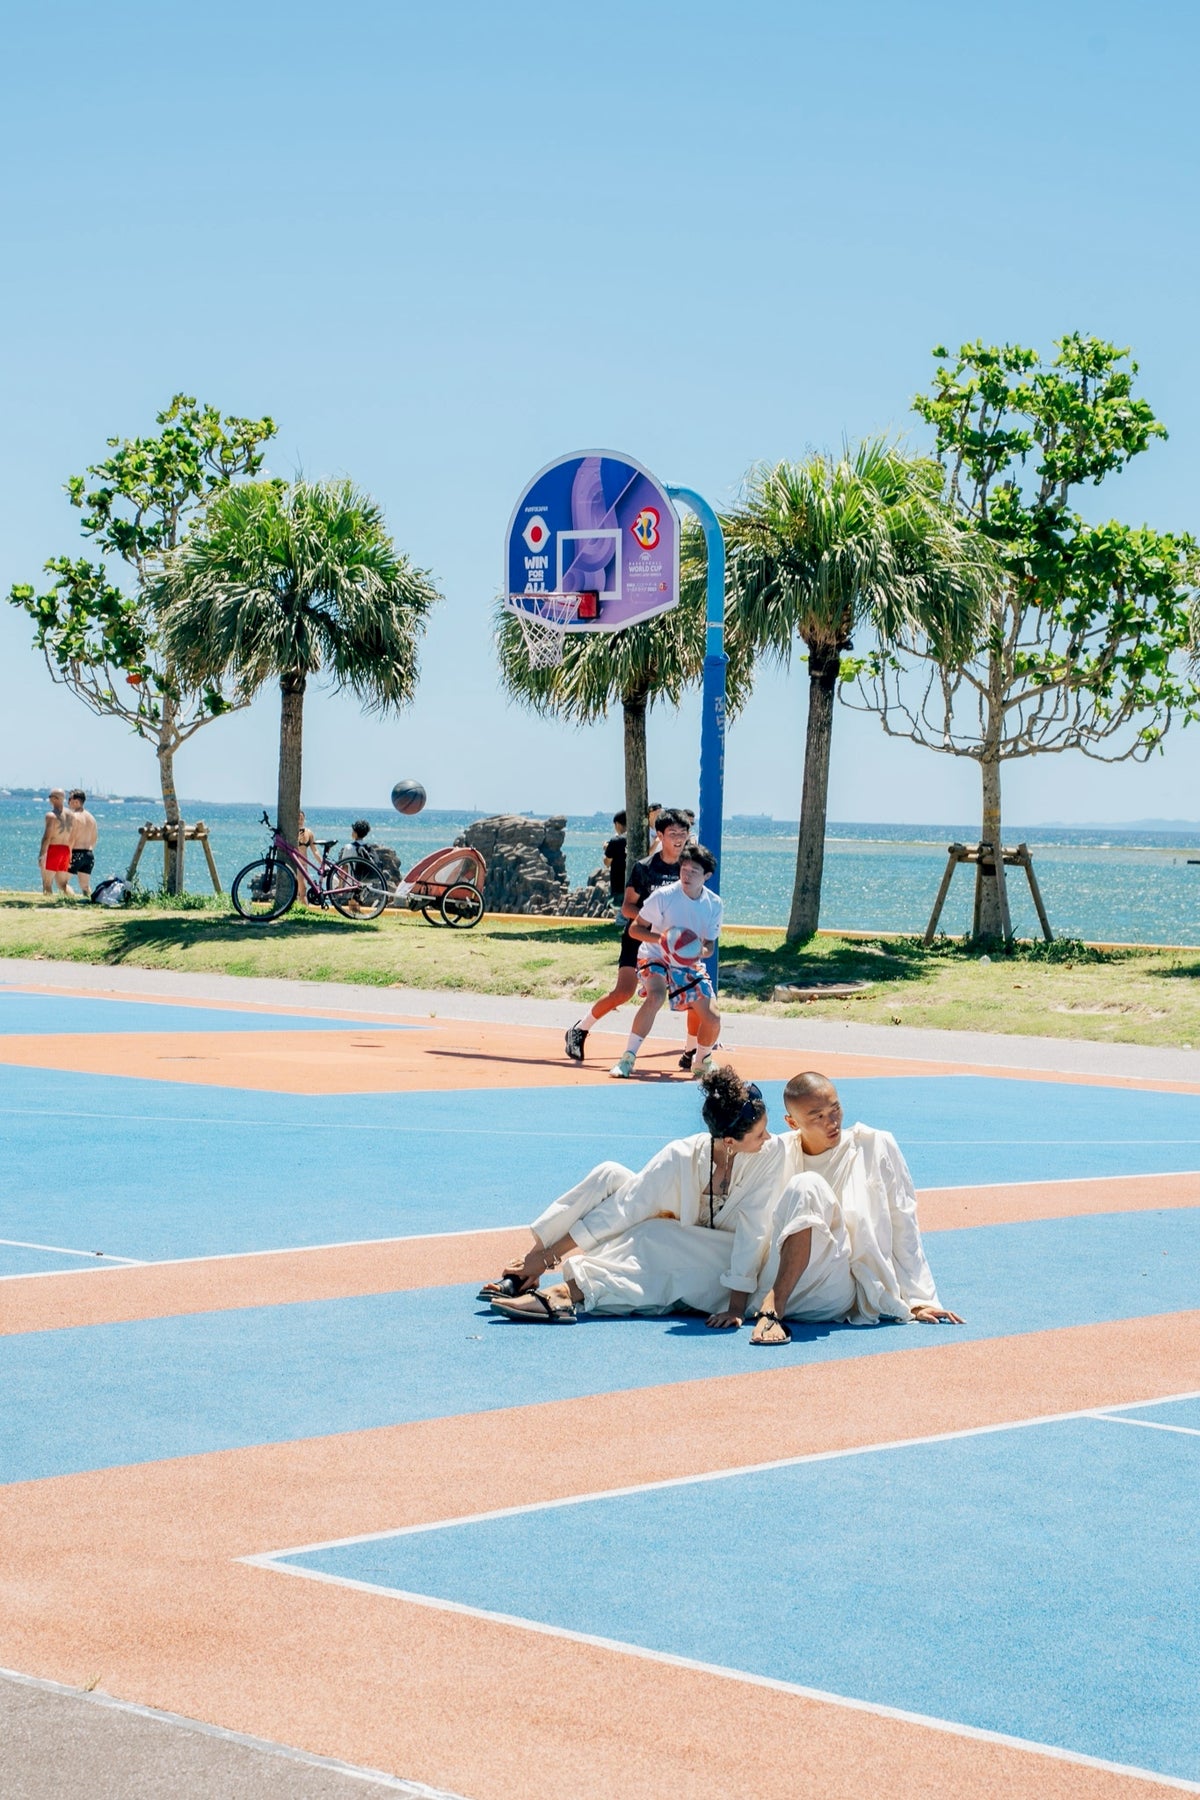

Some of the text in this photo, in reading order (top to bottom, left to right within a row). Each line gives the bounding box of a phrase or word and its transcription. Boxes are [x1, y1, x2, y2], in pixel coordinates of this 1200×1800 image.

[524, 555, 549, 570] WIN
[528, 569, 544, 579] FOR
[628, 564, 663, 573] WORLD CUP
[523, 581, 549, 594] ALL
